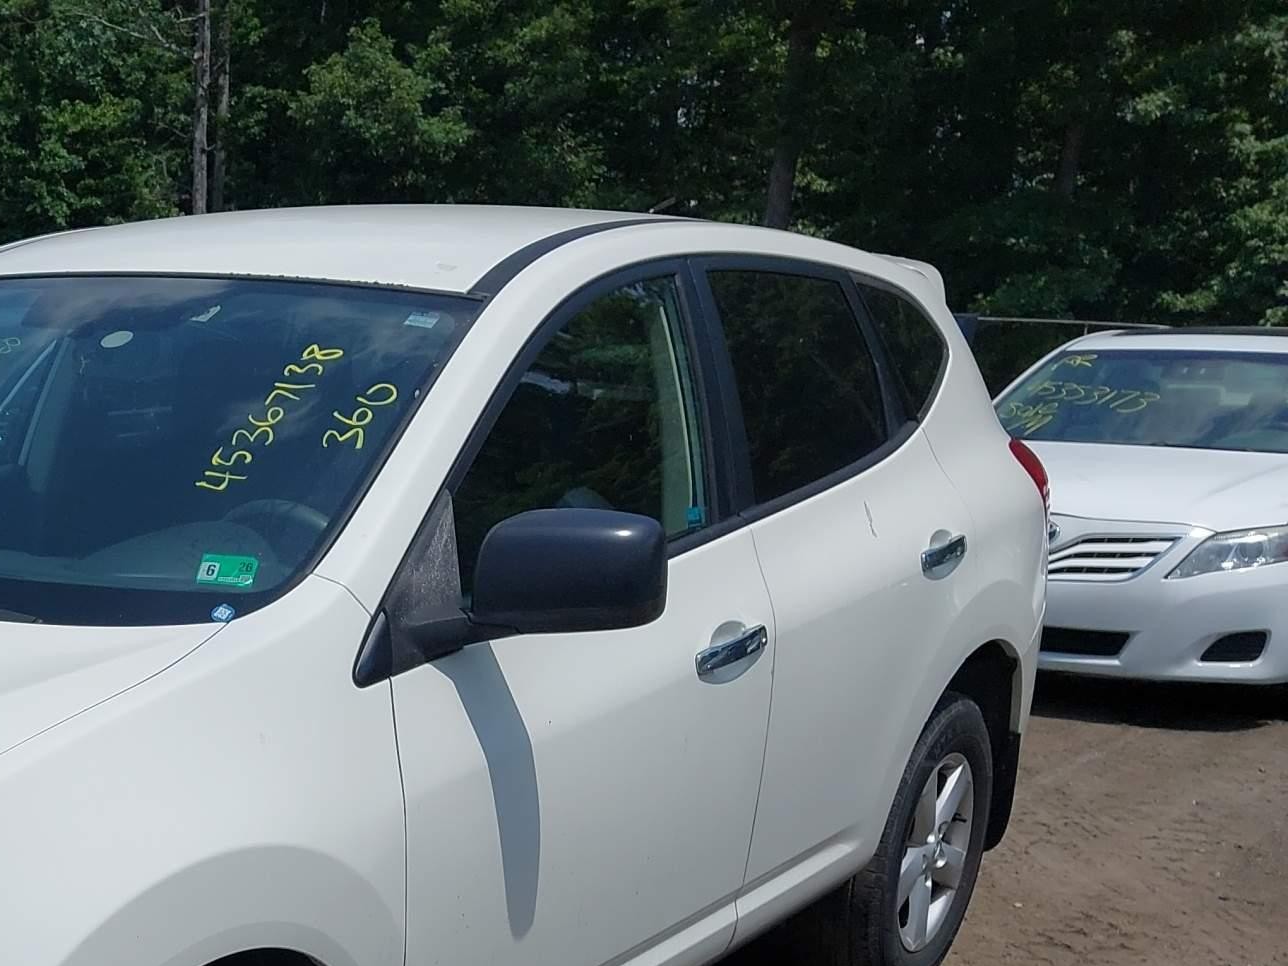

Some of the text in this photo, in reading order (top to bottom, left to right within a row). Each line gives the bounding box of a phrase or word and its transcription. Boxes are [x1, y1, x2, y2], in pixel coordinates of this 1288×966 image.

[194, 343, 345, 491] 45367138
[322, 383, 399, 450] 360
[205, 561, 254, 577] 6 26
